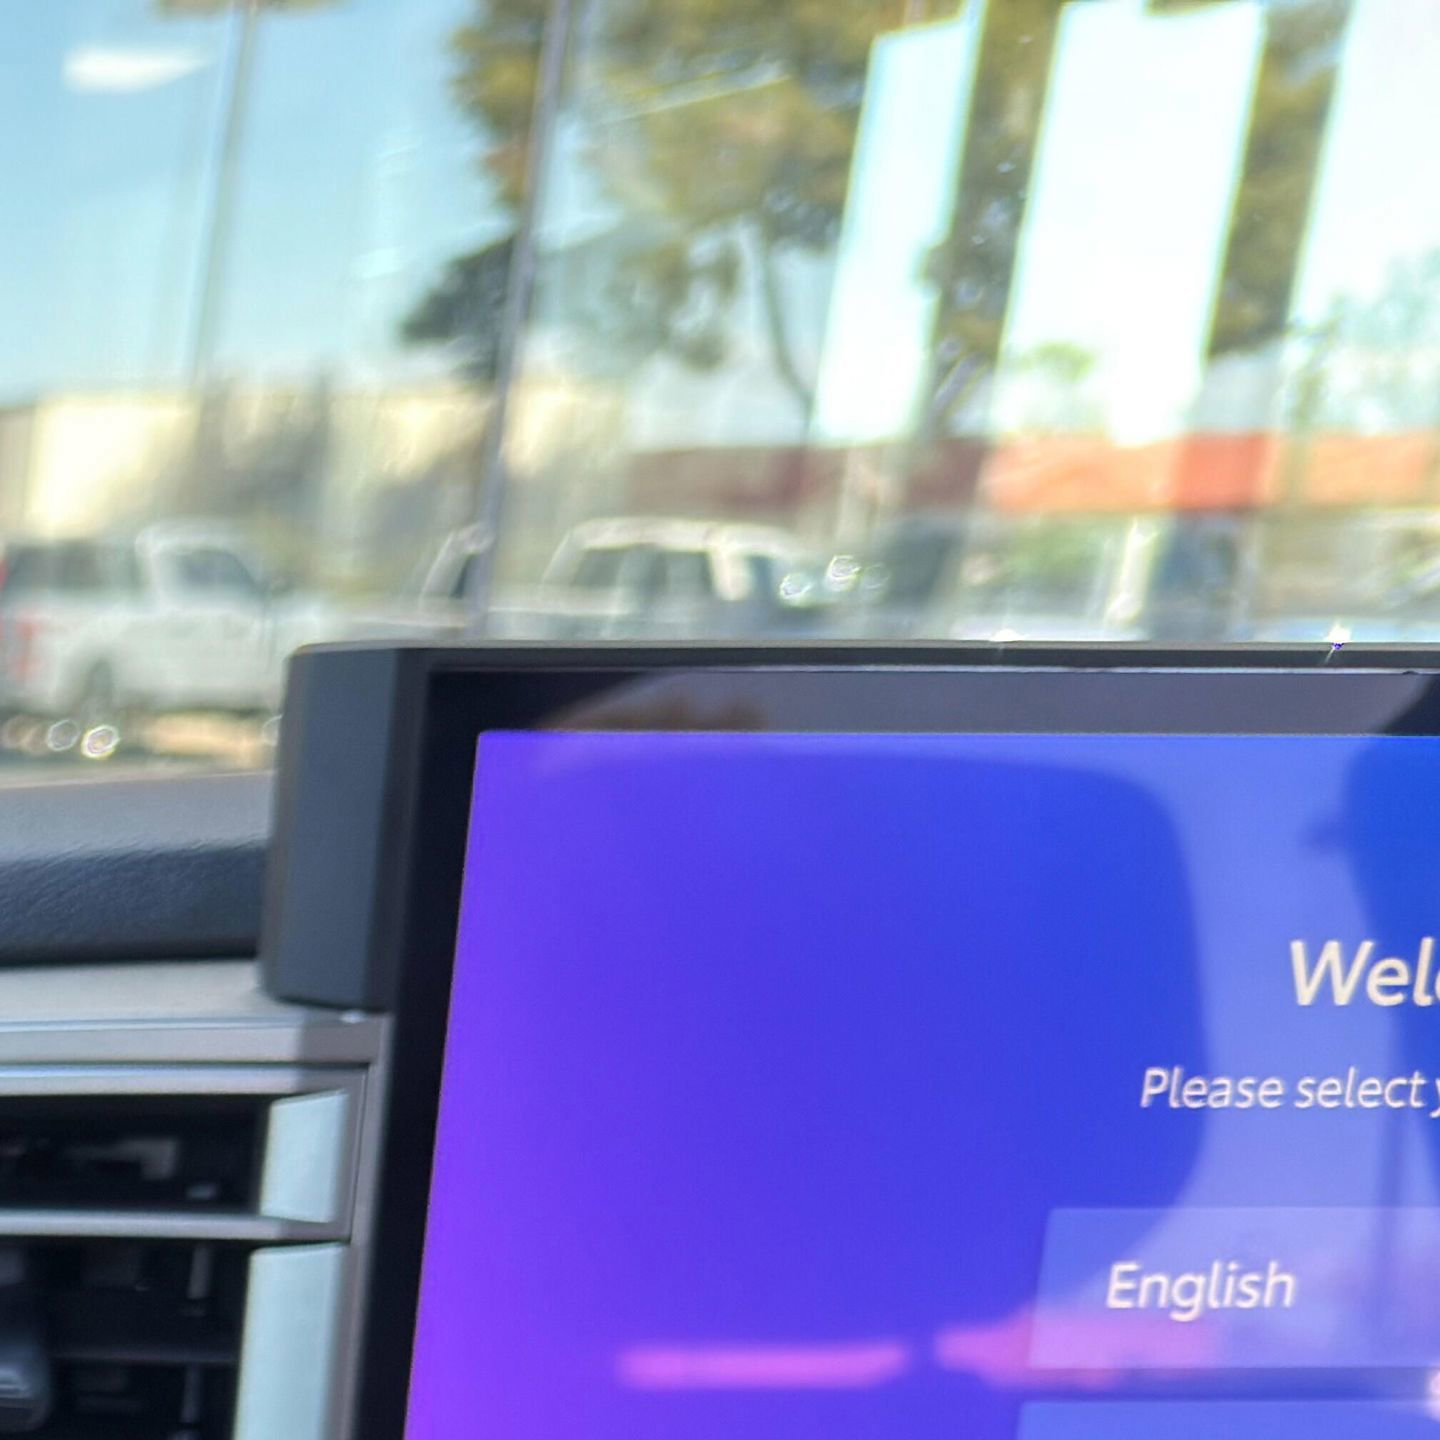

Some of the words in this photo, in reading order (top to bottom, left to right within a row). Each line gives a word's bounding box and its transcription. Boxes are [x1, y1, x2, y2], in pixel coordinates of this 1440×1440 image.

[1290, 937, 1440, 1007] Wel
[1140, 1065, 1285, 1109] Please
[1294, 1065, 1427, 1109] select
[1105, 1259, 1297, 1322] English
